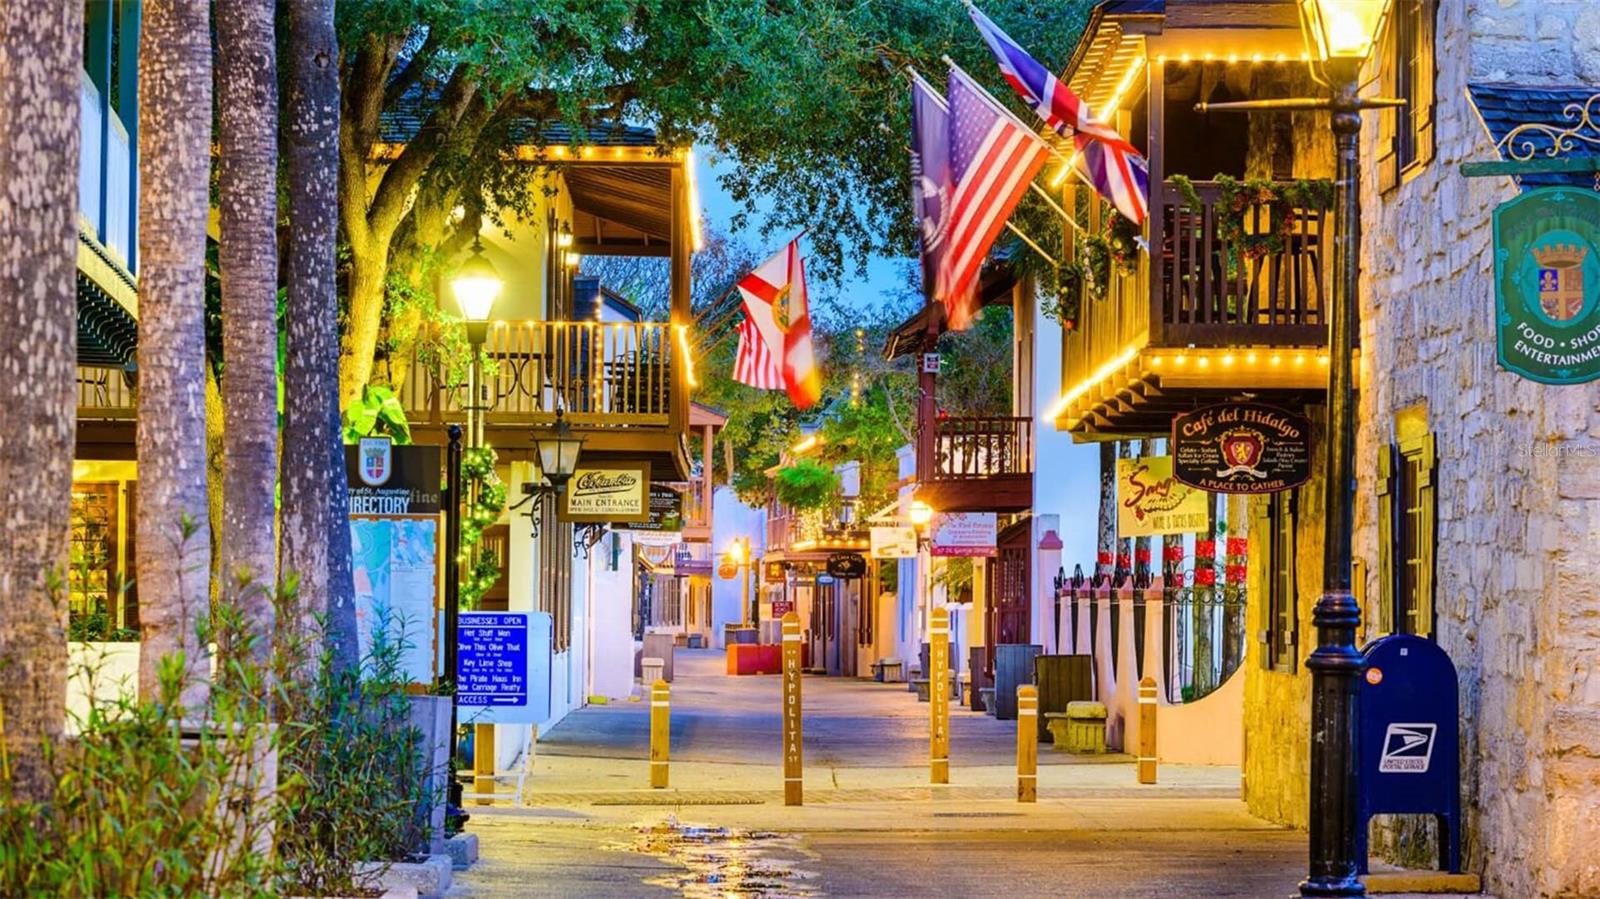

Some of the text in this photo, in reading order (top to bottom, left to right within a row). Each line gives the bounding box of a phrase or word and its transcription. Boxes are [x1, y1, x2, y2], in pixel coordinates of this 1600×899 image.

[1517, 322, 1555, 349] FOOD
[1183, 408, 1300, 439] Café del Hidalgo
[1208, 480, 1233, 490] PLACE
[1251, 480, 1285, 490] GATHER
[375, 487, 410, 496] Augustine
[350, 496, 410, 514] IRECTORY
[504, 617, 522, 625] OPEN
[506, 643, 520, 651] That
[464, 659, 513, 668] Key Lime Shop
[472, 684, 497, 692] Carriage
[937, 651, 945, 735] HYPOLITA
[458, 696, 488, 704] ACCESS
[788, 659, 798, 753] HYPOLITA
